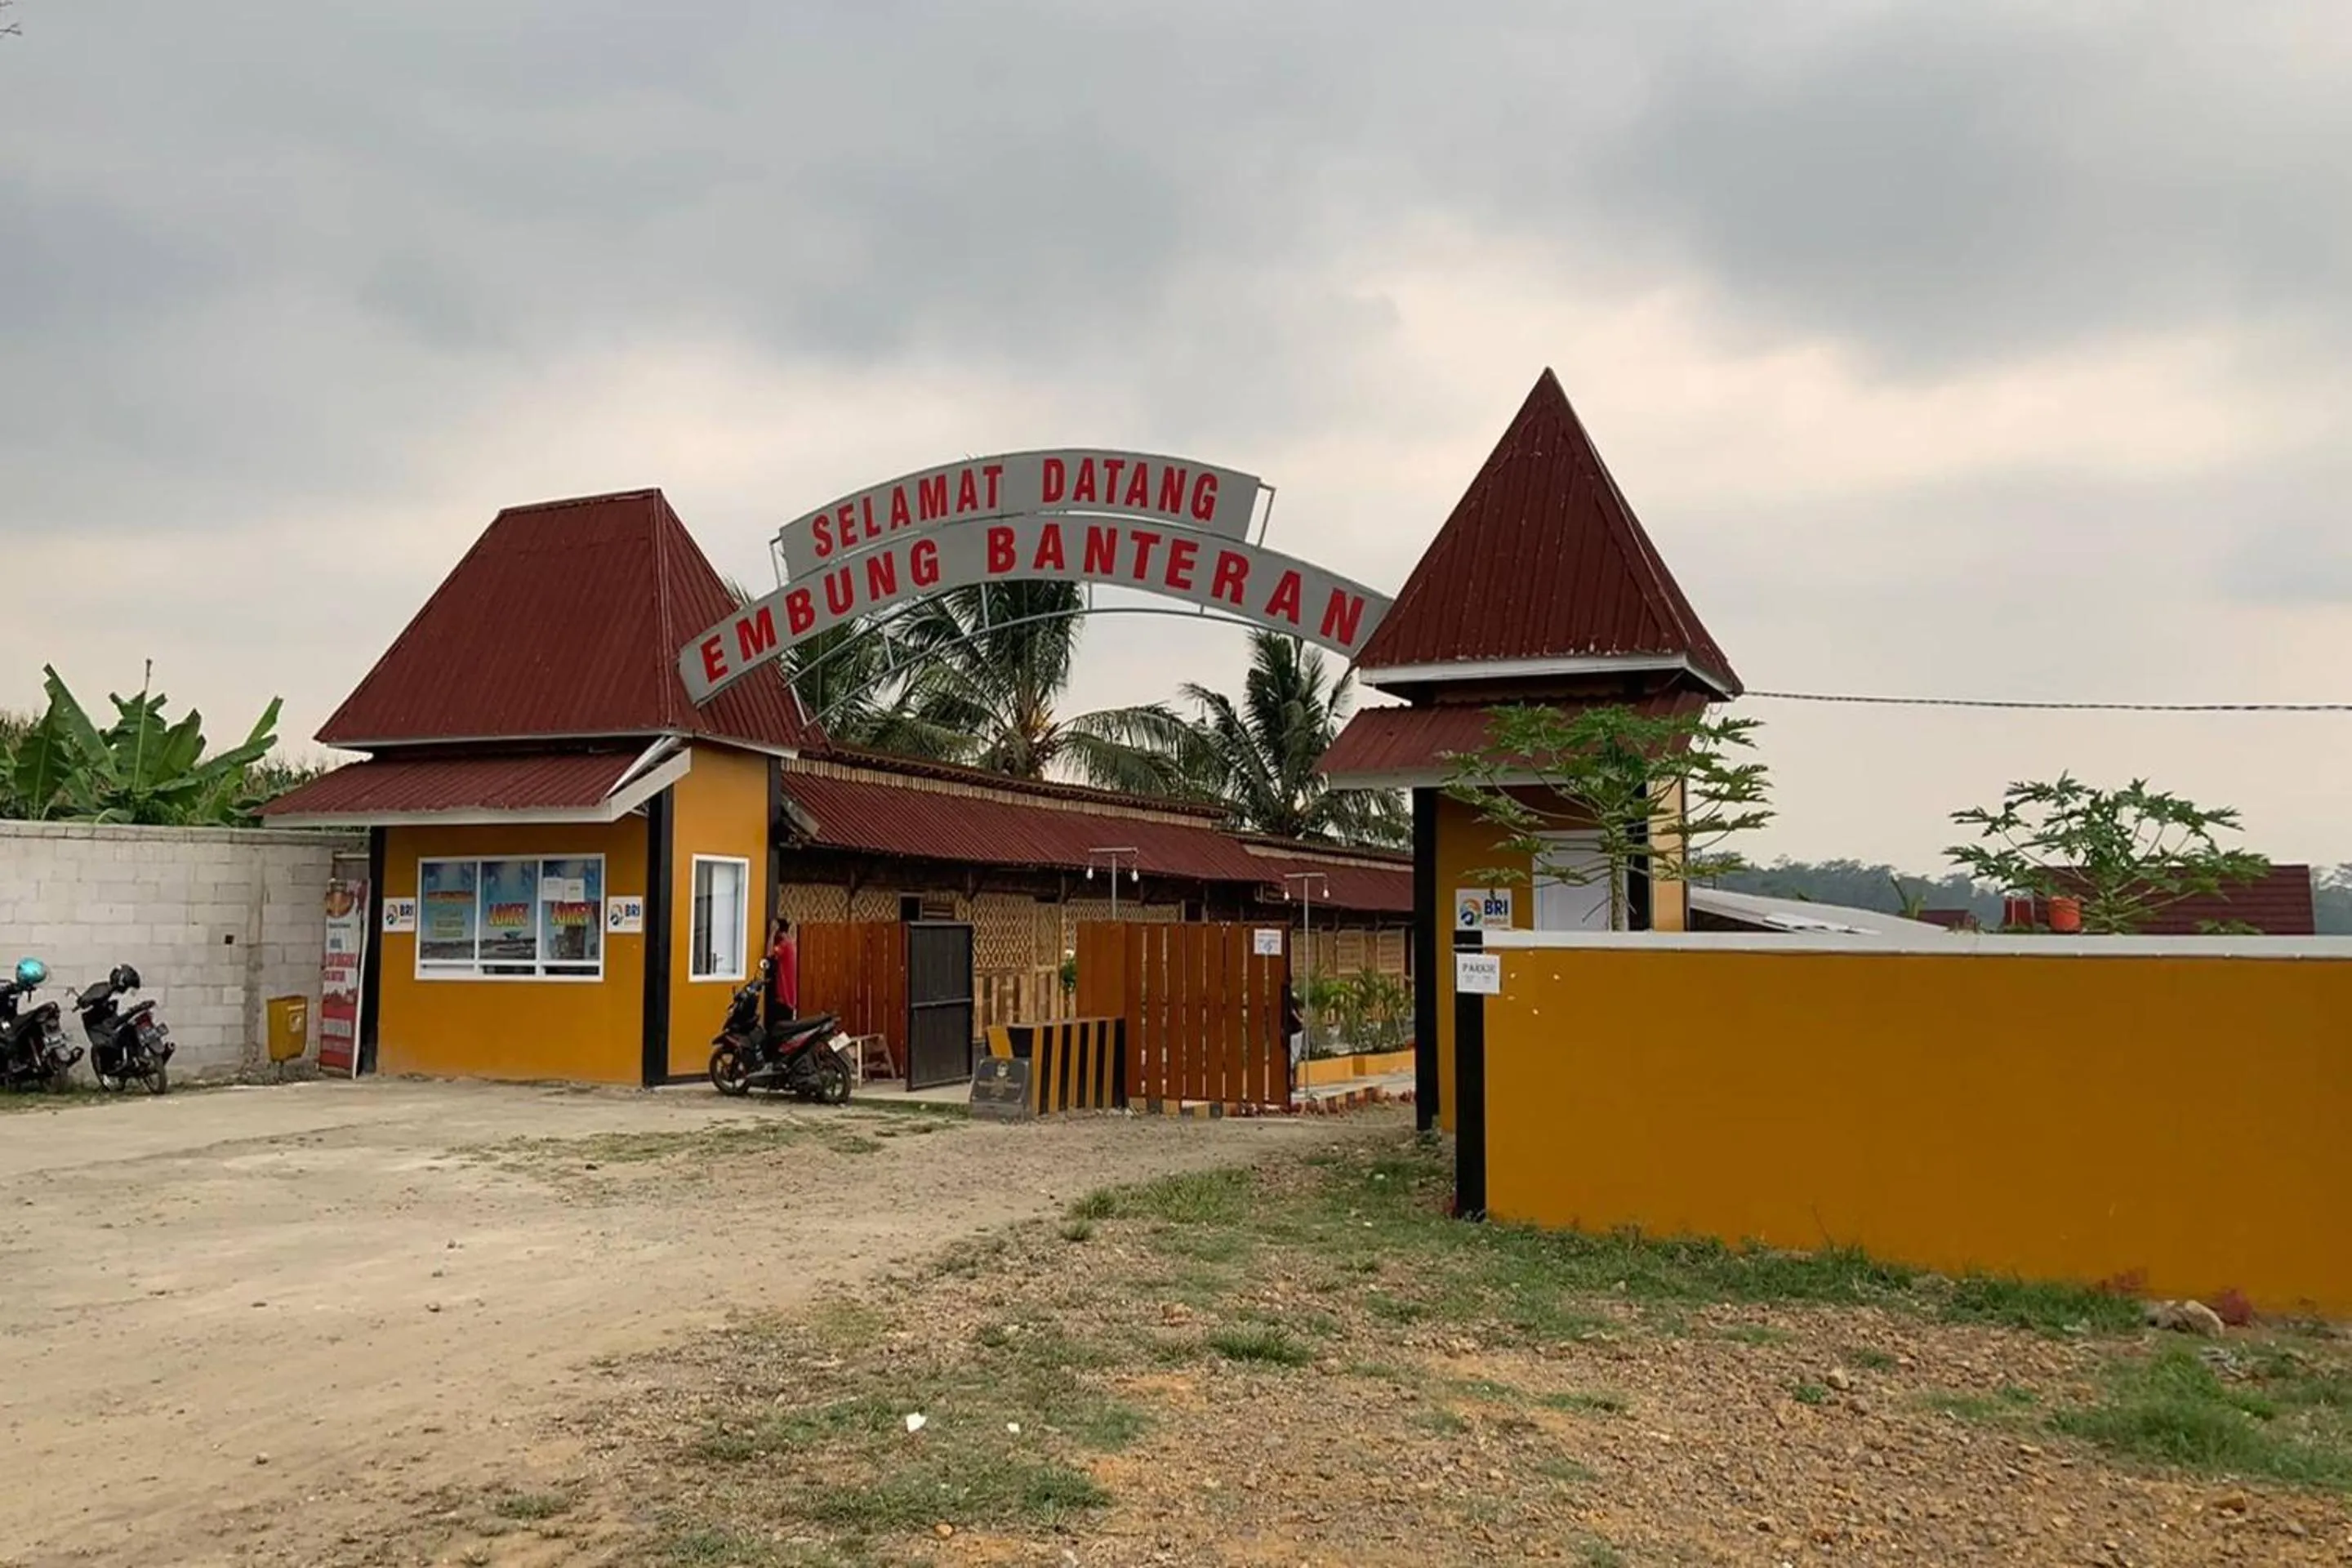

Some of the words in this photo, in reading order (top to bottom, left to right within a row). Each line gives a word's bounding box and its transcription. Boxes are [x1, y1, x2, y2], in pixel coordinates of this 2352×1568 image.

[813, 465, 1003, 558] SELAMAT
[1043, 457, 1218, 520] DATANG
[700, 539, 940, 684] EMBUNG
[987, 523, 1364, 646] BANTERAN
[400, 903, 414, 916] BRI
[625, 903, 640, 916] BRI
[1484, 899, 1508, 915] BRI
